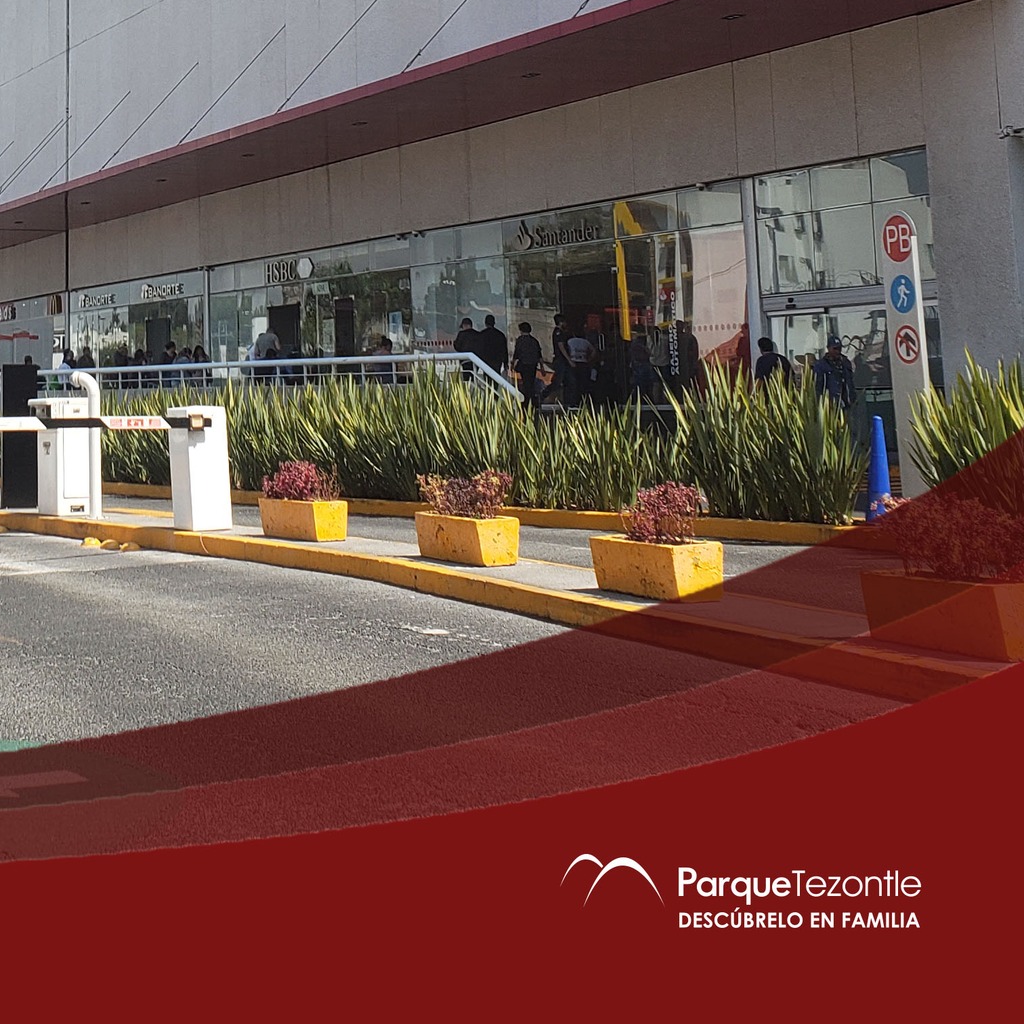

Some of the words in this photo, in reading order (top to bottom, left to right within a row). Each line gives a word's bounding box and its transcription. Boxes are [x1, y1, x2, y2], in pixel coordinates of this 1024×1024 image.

[534, 219, 598, 248] Santander
[886, 224, 911, 253] PB
[265, 259, 296, 284] HSBC
[85, 294, 112, 307] BANORTE
[148, 283, 180, 298] BANORTE
[668, 324, 676, 375] CAJERO
